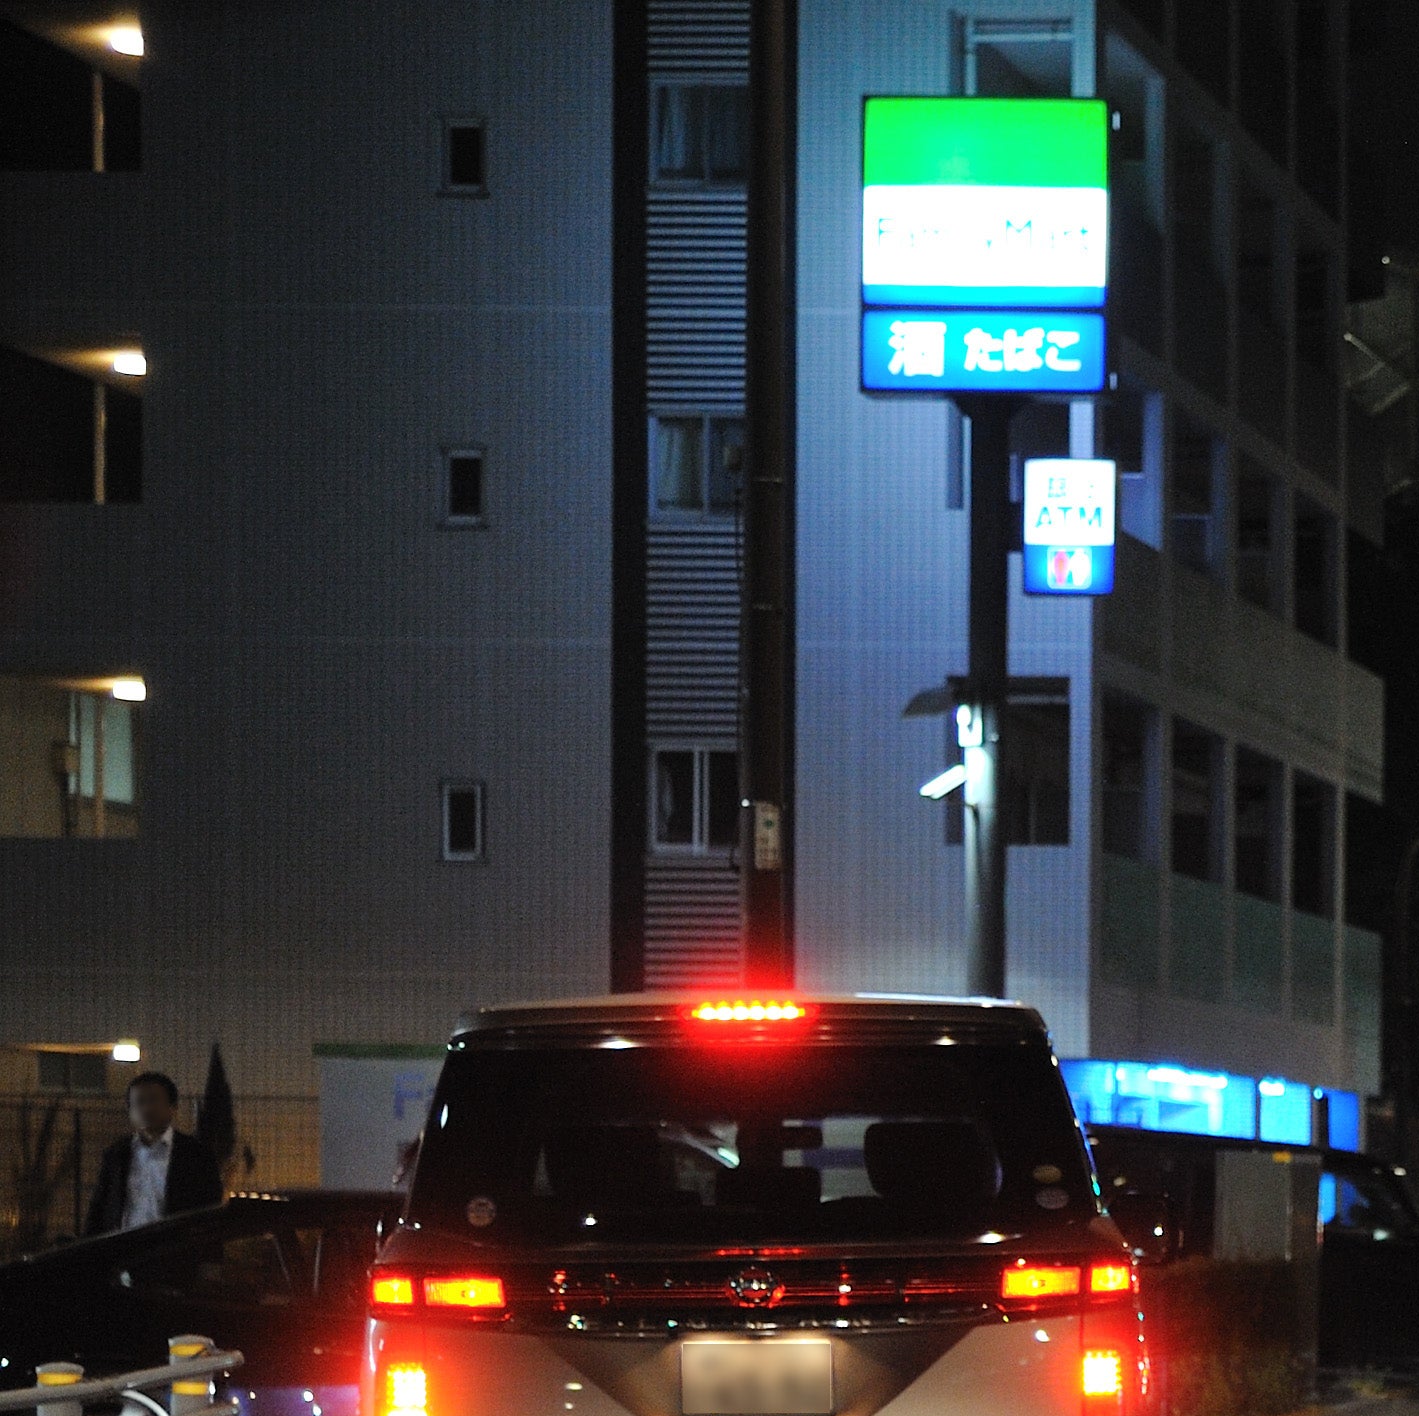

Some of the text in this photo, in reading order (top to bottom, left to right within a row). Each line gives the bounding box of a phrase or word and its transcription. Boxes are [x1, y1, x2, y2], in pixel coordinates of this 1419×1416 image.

[876, 216, 1089, 254] FmyMrt
[887, 319, 1082, 379] 酒 たばこ
[1034, 505, 1104, 529] ATM
